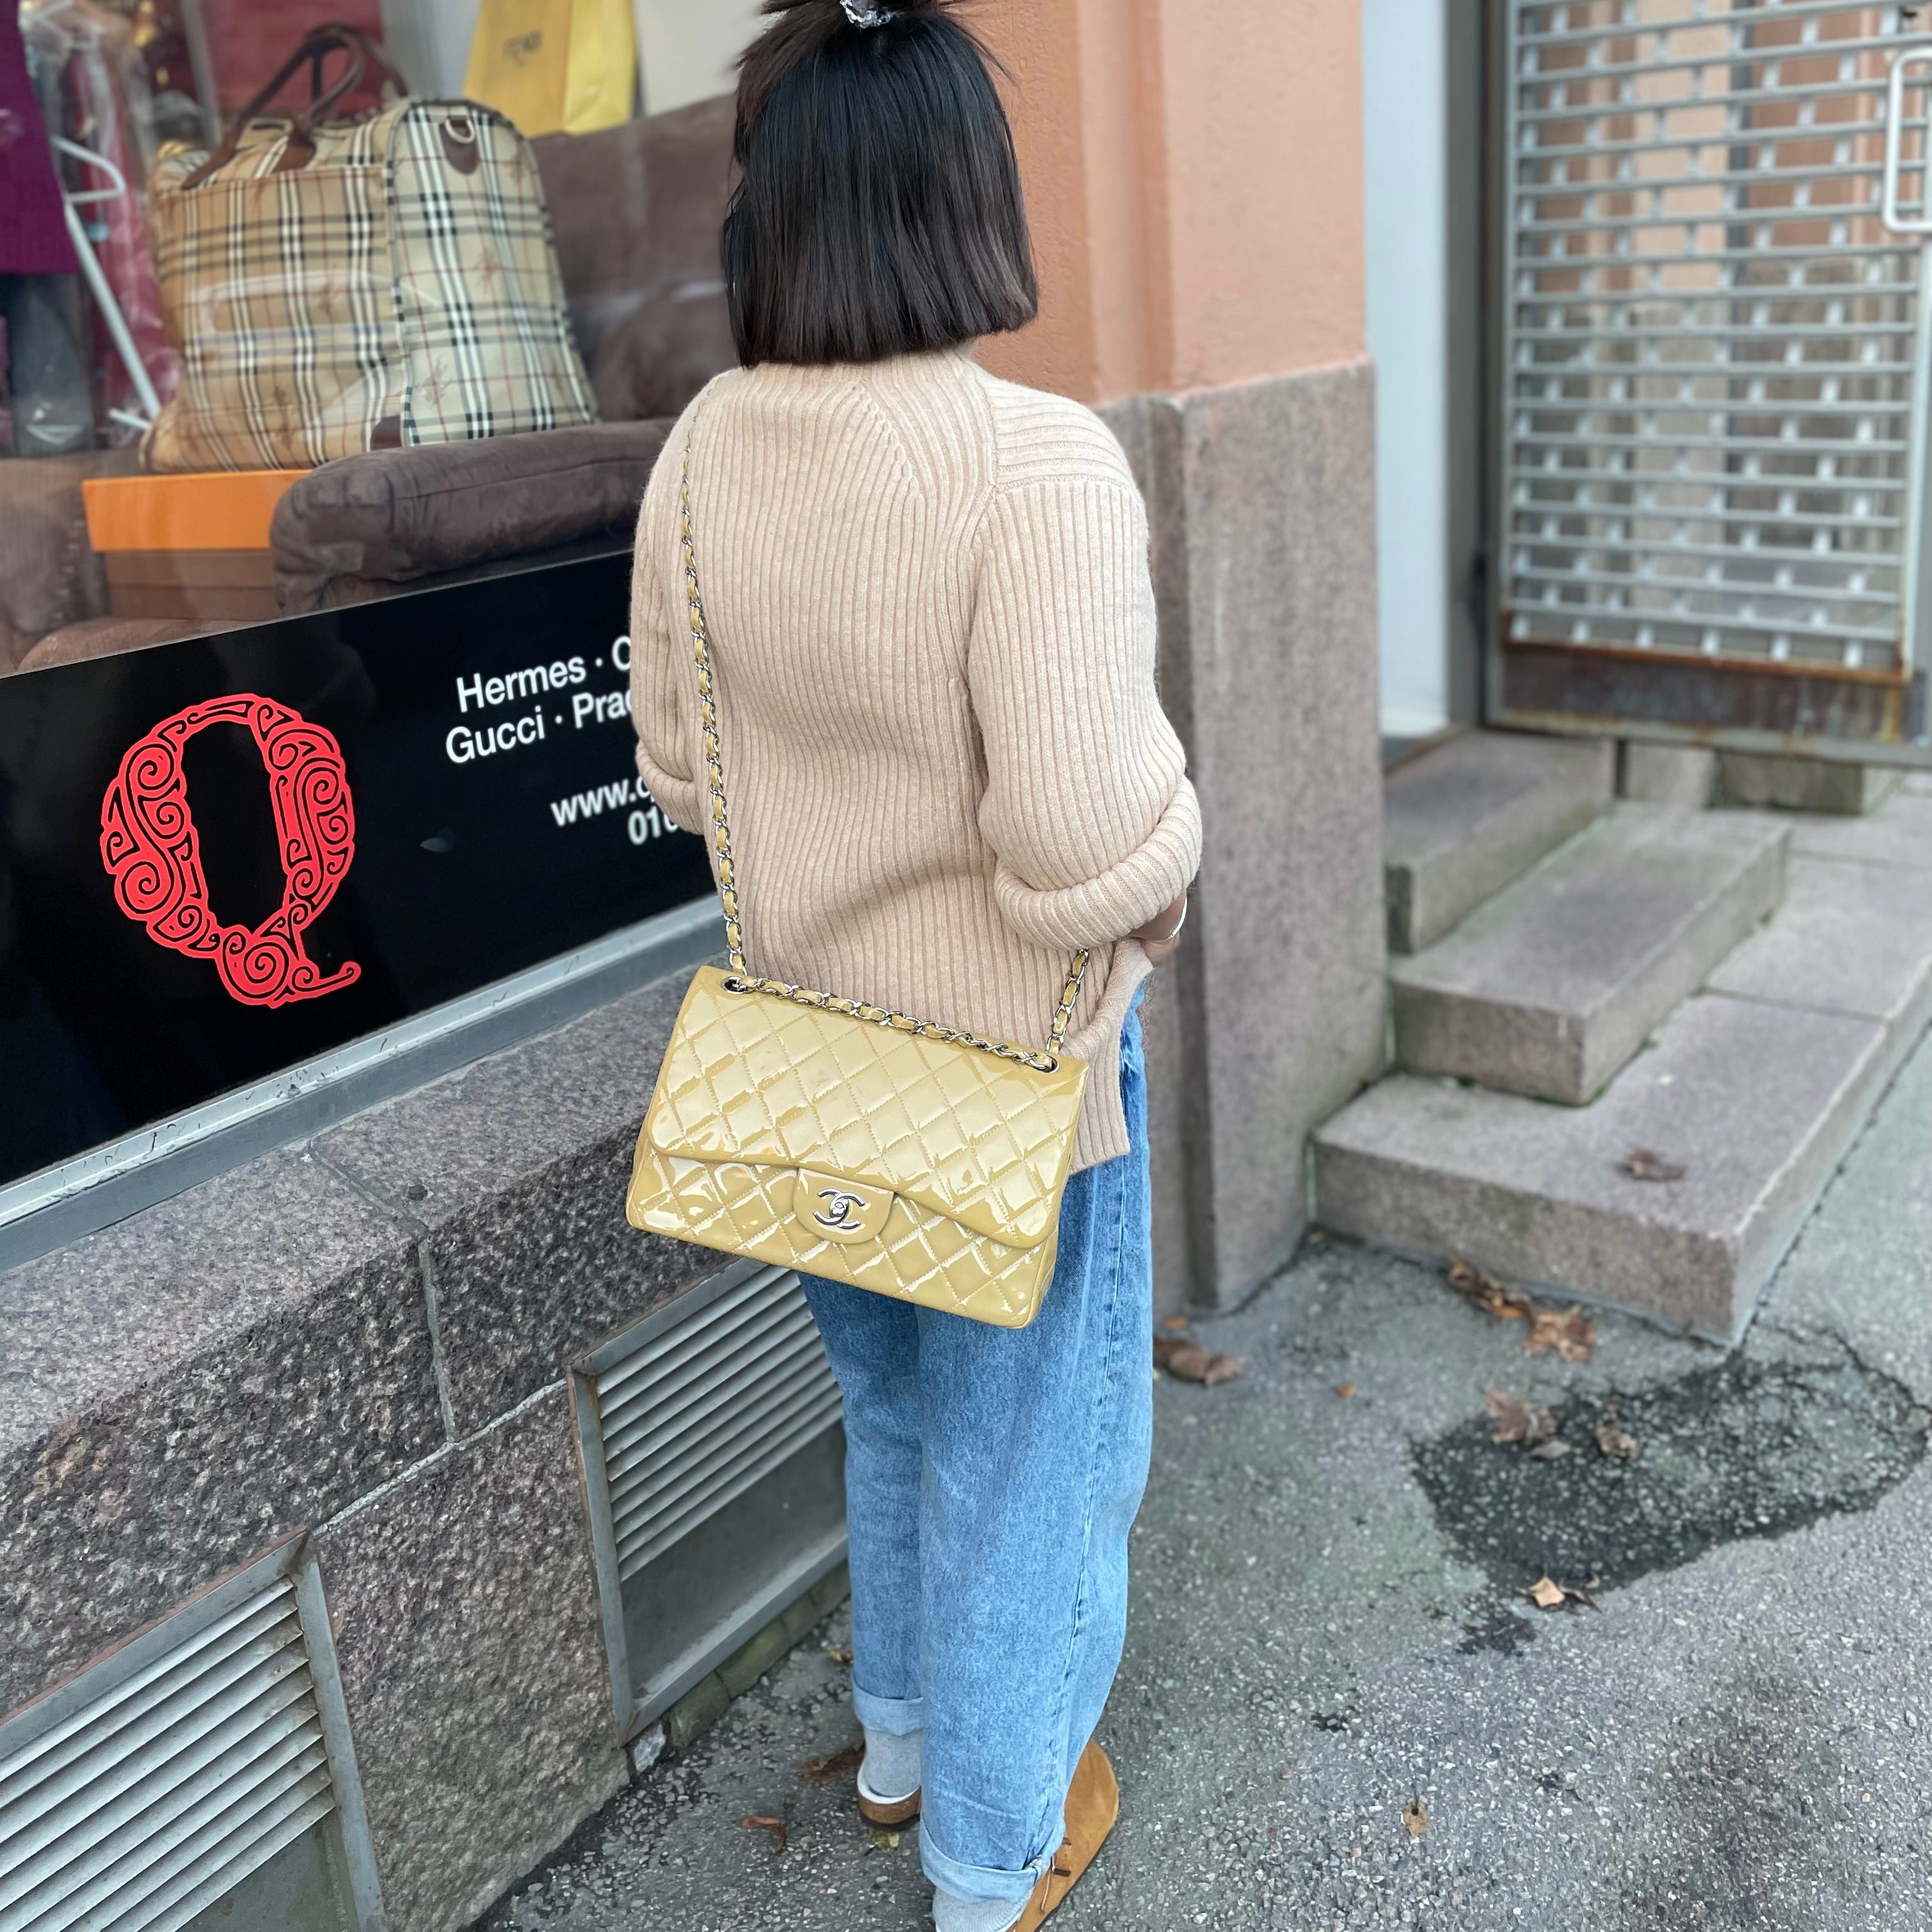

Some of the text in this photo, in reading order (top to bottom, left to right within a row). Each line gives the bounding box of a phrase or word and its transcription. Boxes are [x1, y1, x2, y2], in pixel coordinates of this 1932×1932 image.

[456, 656, 586, 713] Hermes
[445, 705, 545, 763] Gucci
[99, 693, 362, 1009] Q
